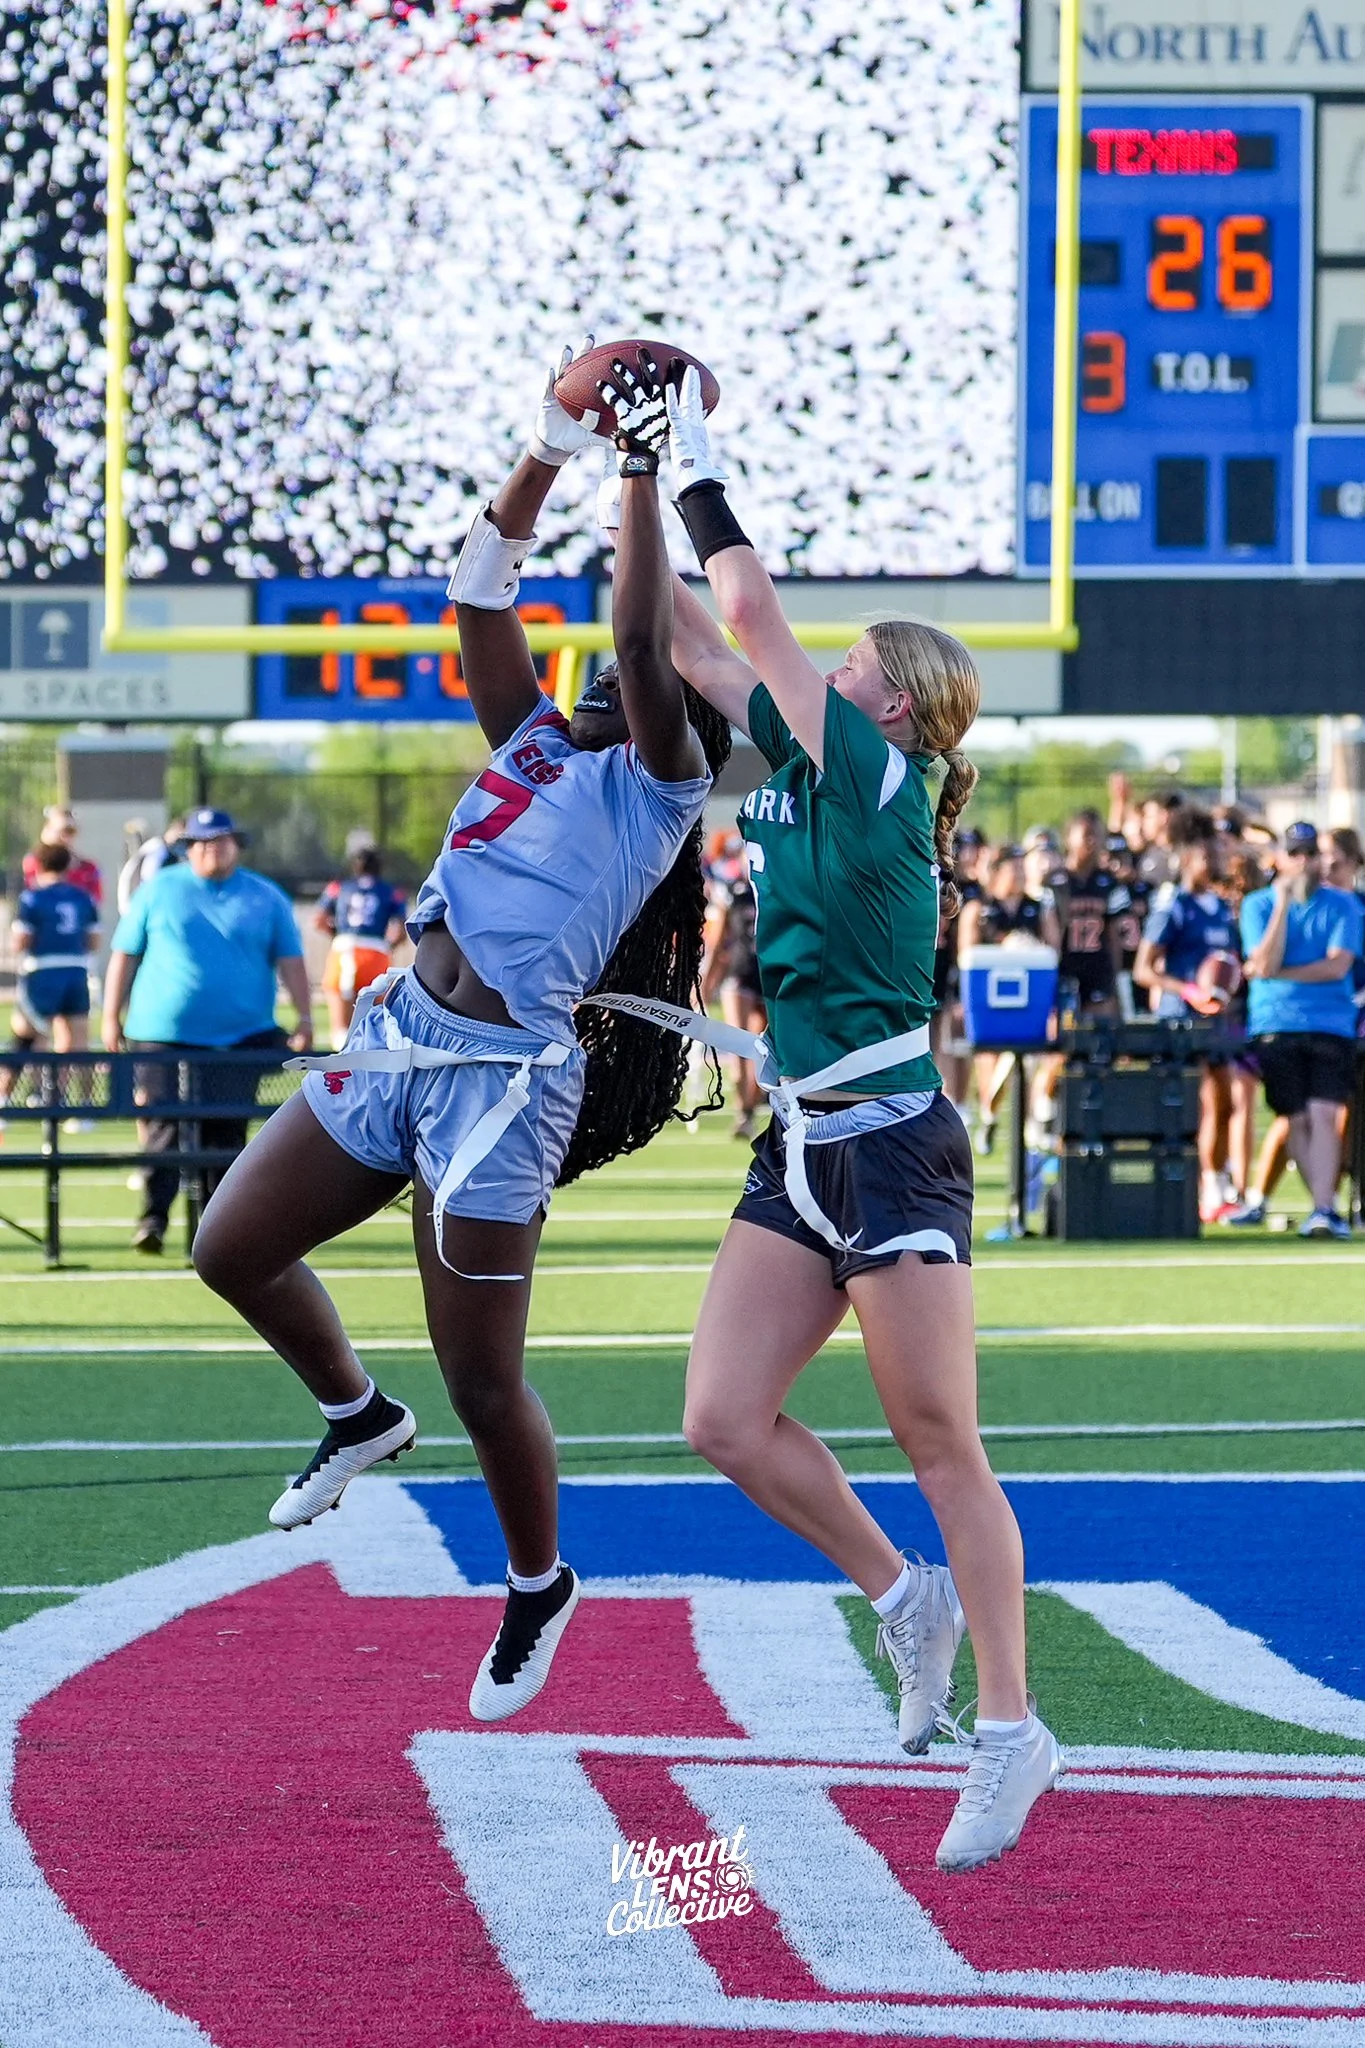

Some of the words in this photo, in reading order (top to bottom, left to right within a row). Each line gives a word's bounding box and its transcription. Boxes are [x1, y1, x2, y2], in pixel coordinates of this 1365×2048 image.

[1147, 214, 1273, 311] 26
[1081, 331, 1126, 413] 3
[23, 677, 171, 706] SPACES
[512, 739, 565, 785] EISS
[450, 769, 536, 850] 7
[738, 788, 796, 825] ARK
[55, 902, 77, 934] 3
